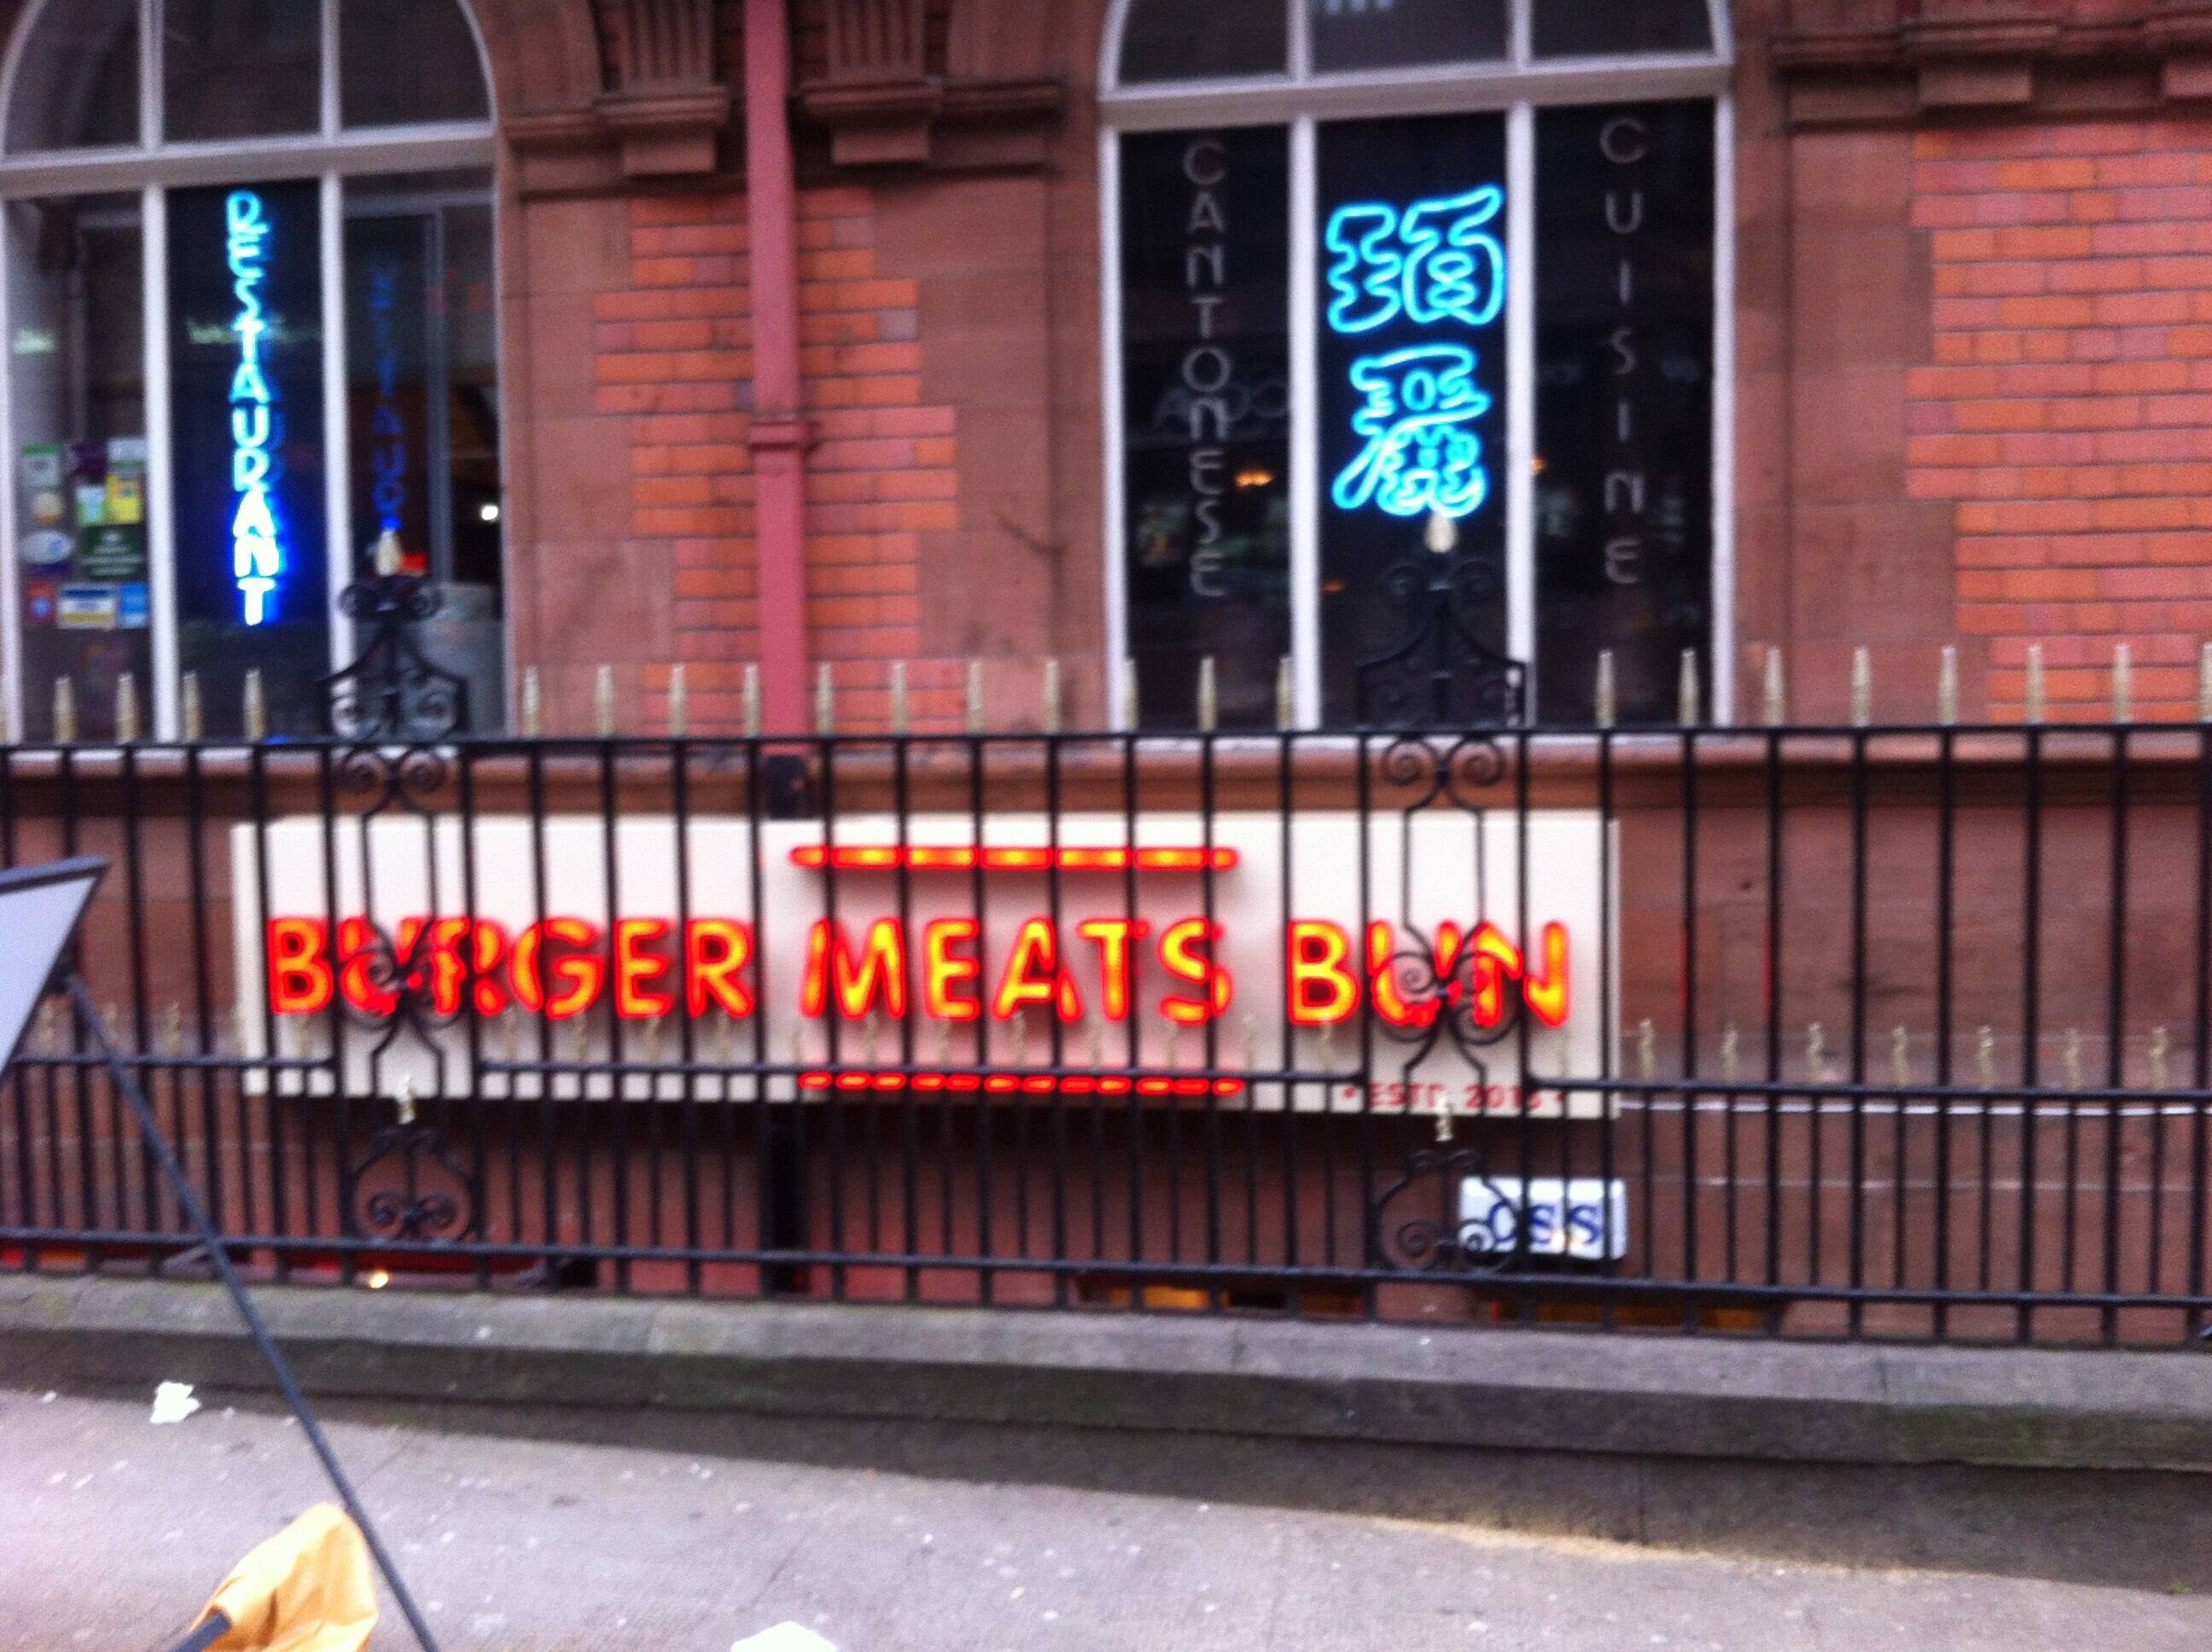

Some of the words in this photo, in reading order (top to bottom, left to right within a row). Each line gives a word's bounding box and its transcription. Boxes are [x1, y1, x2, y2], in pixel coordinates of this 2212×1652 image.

[226, 190, 281, 626] RESTAURANT
[1182, 139, 1231, 598] CANTONESE
[1599, 116, 1647, 586] CUISINE
[266, 915, 758, 1020] BURGER
[800, 916, 1235, 1025] MEATS
[1286, 918, 1571, 1029] BUN
